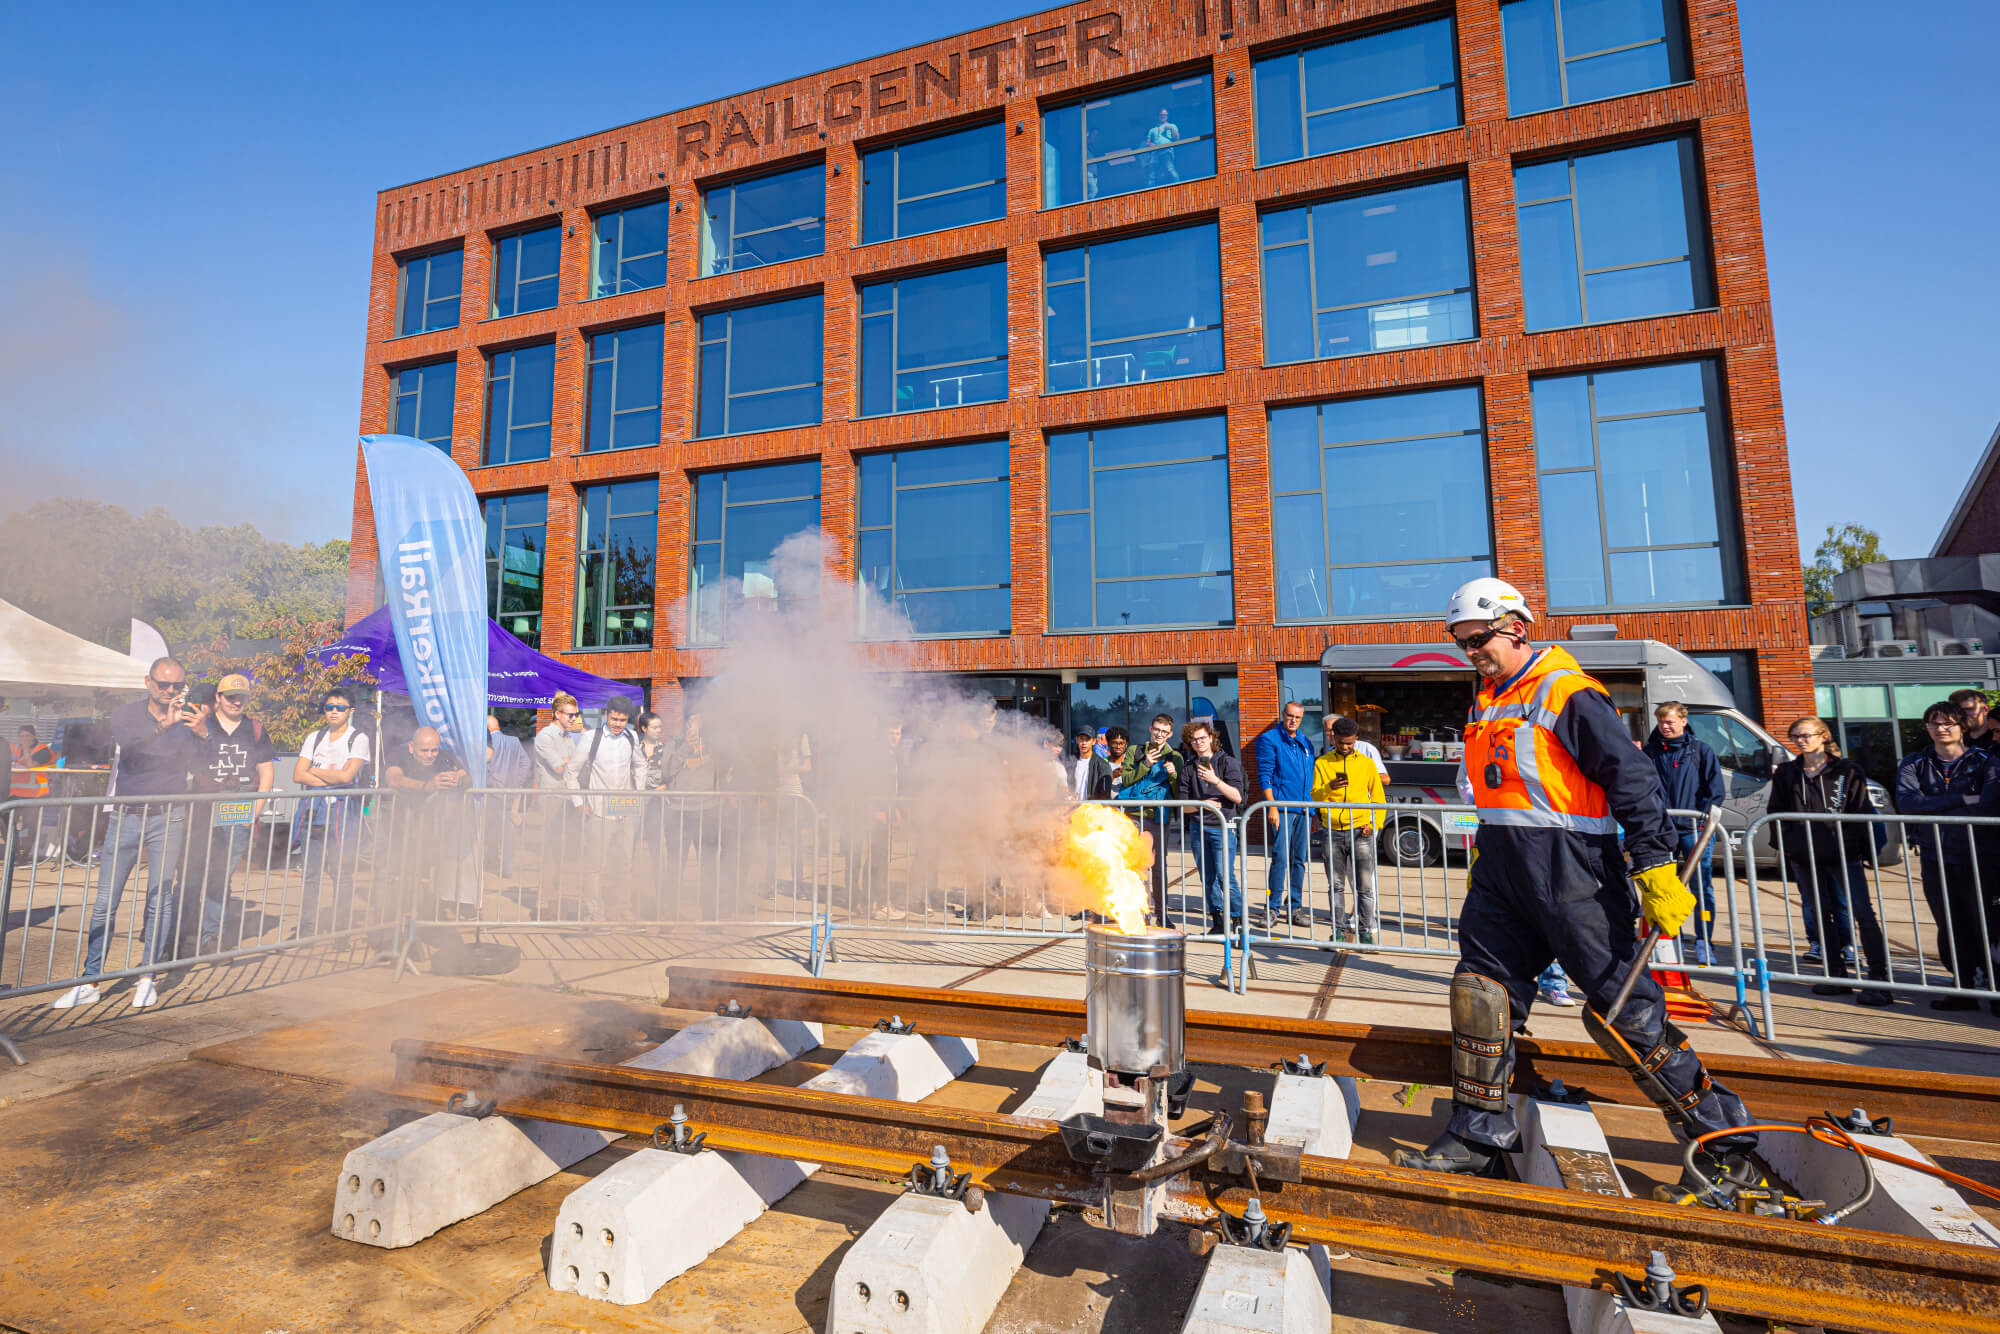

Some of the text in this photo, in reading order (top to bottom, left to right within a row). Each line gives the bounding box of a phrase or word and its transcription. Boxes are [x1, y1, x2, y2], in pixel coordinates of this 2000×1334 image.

[676, 12, 1123, 166] RAILCENTER
[1471, 1042, 1502, 1054] FENTO
[1458, 1081, 1486, 1096] FENTO
